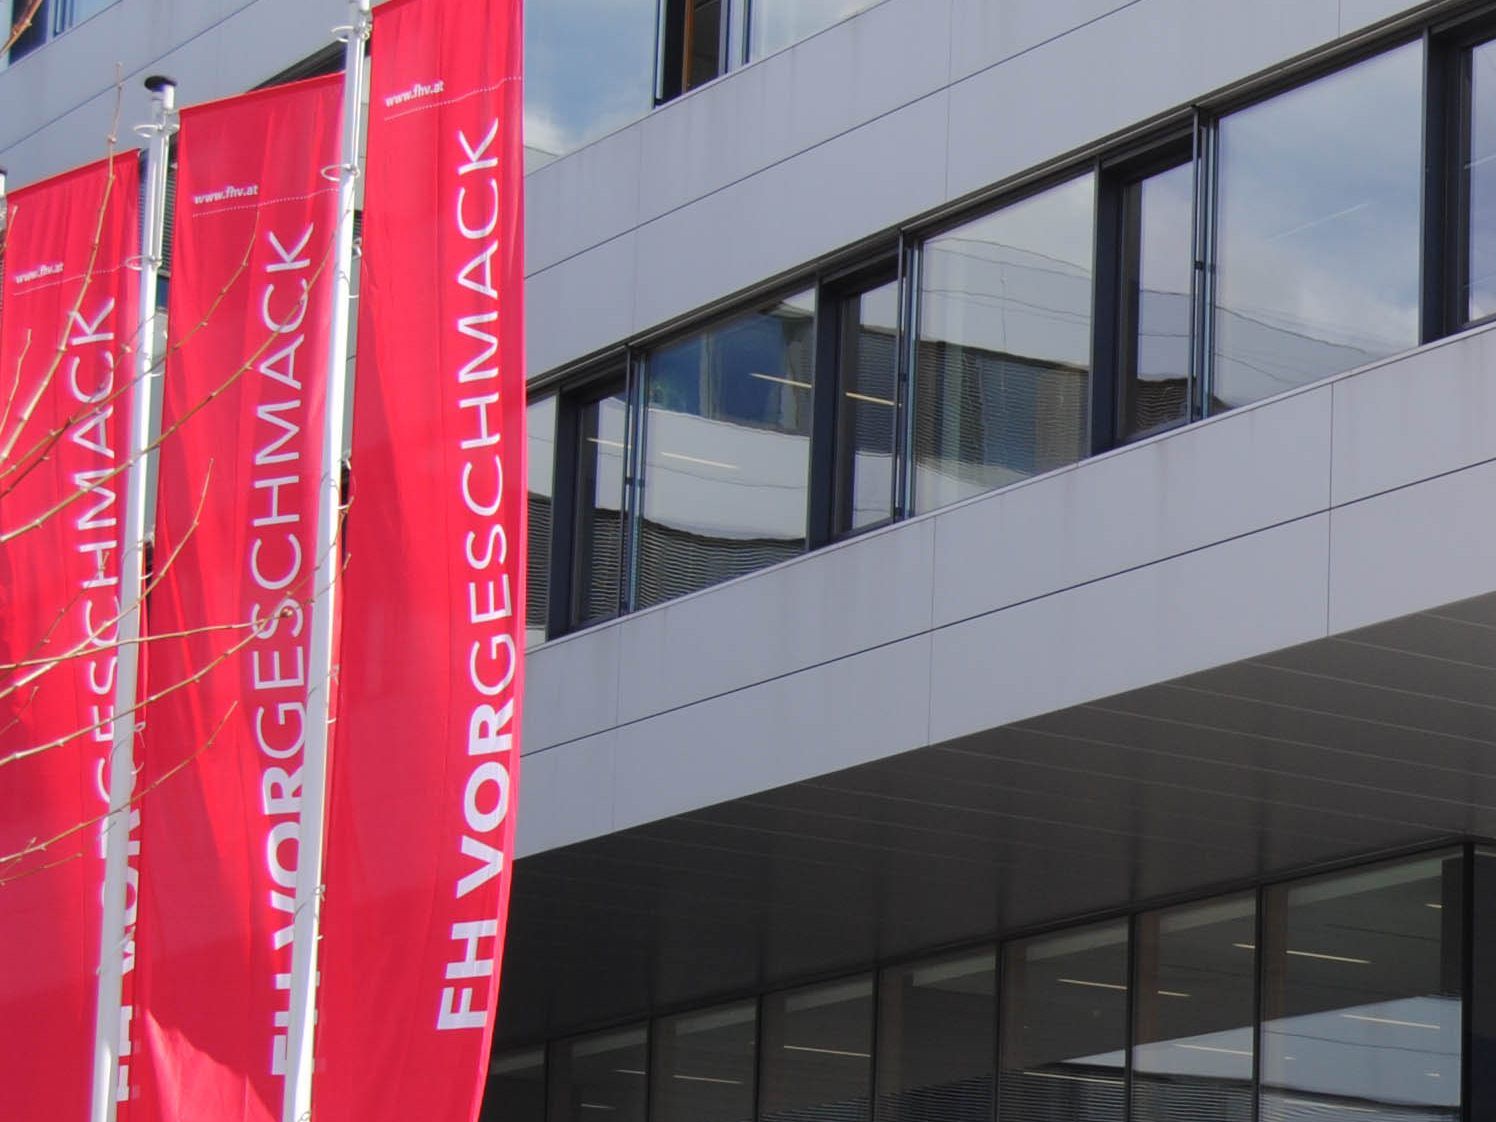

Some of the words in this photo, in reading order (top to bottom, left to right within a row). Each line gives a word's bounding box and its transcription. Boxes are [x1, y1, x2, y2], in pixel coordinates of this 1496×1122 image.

[385, 80, 444, 108] www.fhv.at
[195, 184, 258, 205] www.fhv.at
[15, 261, 64, 284] www.fhv.at
[455, 116, 517, 898] VORGESCHMACK
[436, 919, 499, 1031] FH
